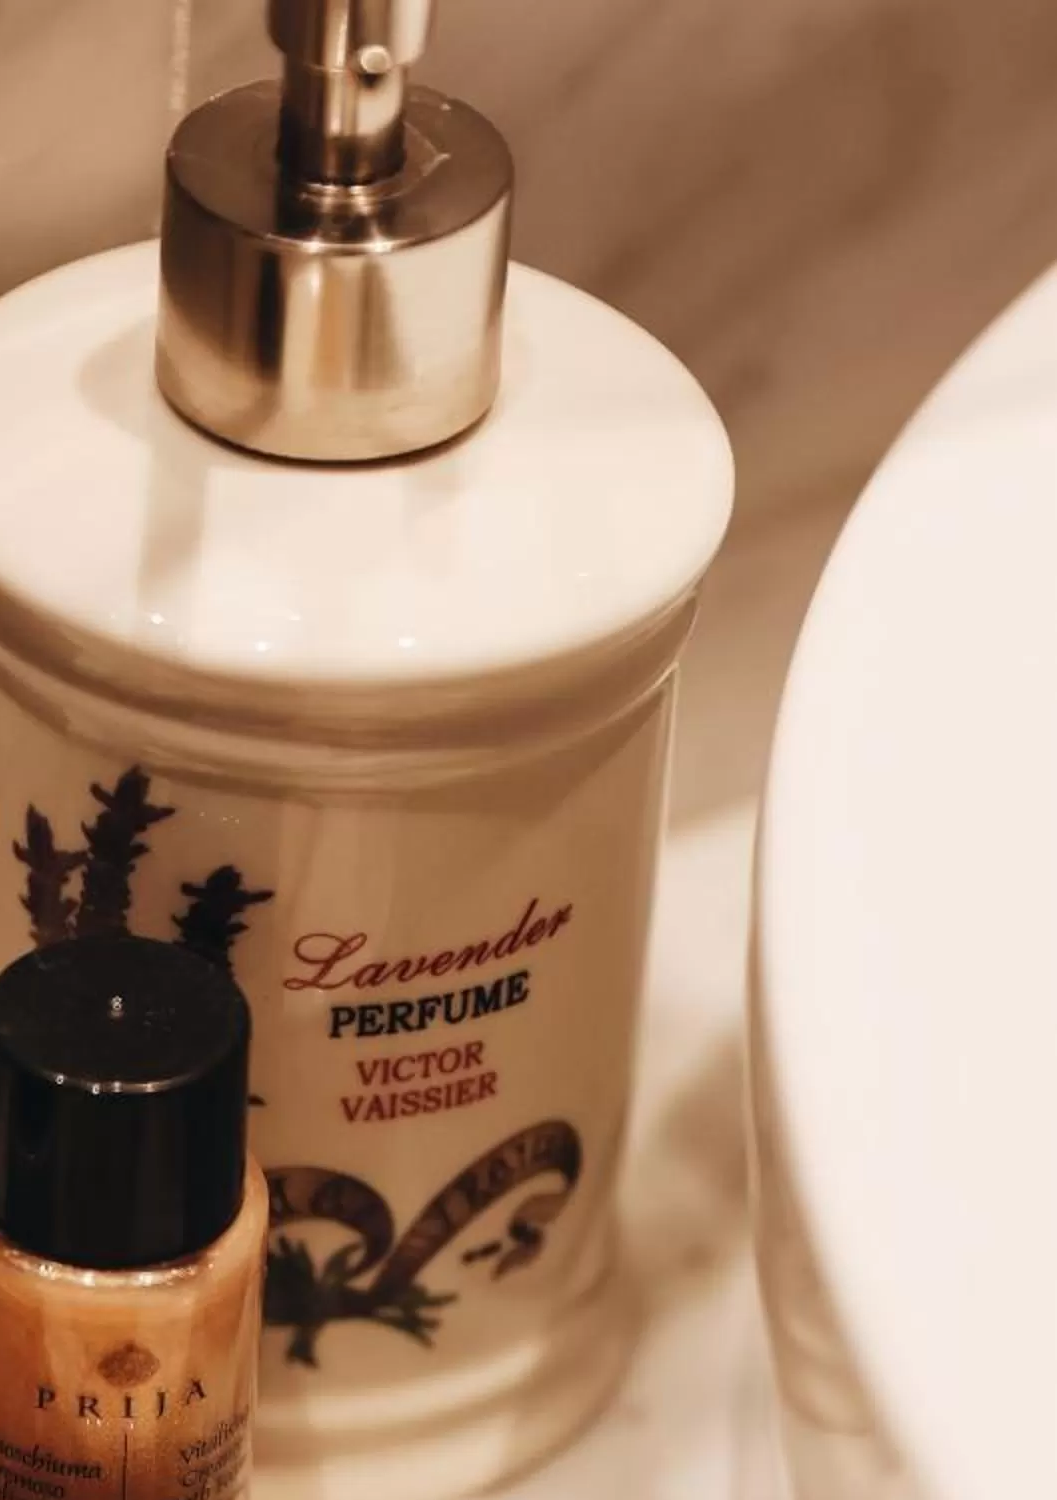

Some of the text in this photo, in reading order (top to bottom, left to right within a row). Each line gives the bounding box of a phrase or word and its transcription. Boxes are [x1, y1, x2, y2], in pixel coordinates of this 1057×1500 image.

[283, 898, 573, 990] Lavender
[328, 969, 531, 1040] PERFUME
[356, 1040, 485, 1086] VICTOR
[340, 1071, 499, 1122] VAISSIER
[34, 1377, 207, 1419] PRIJA
